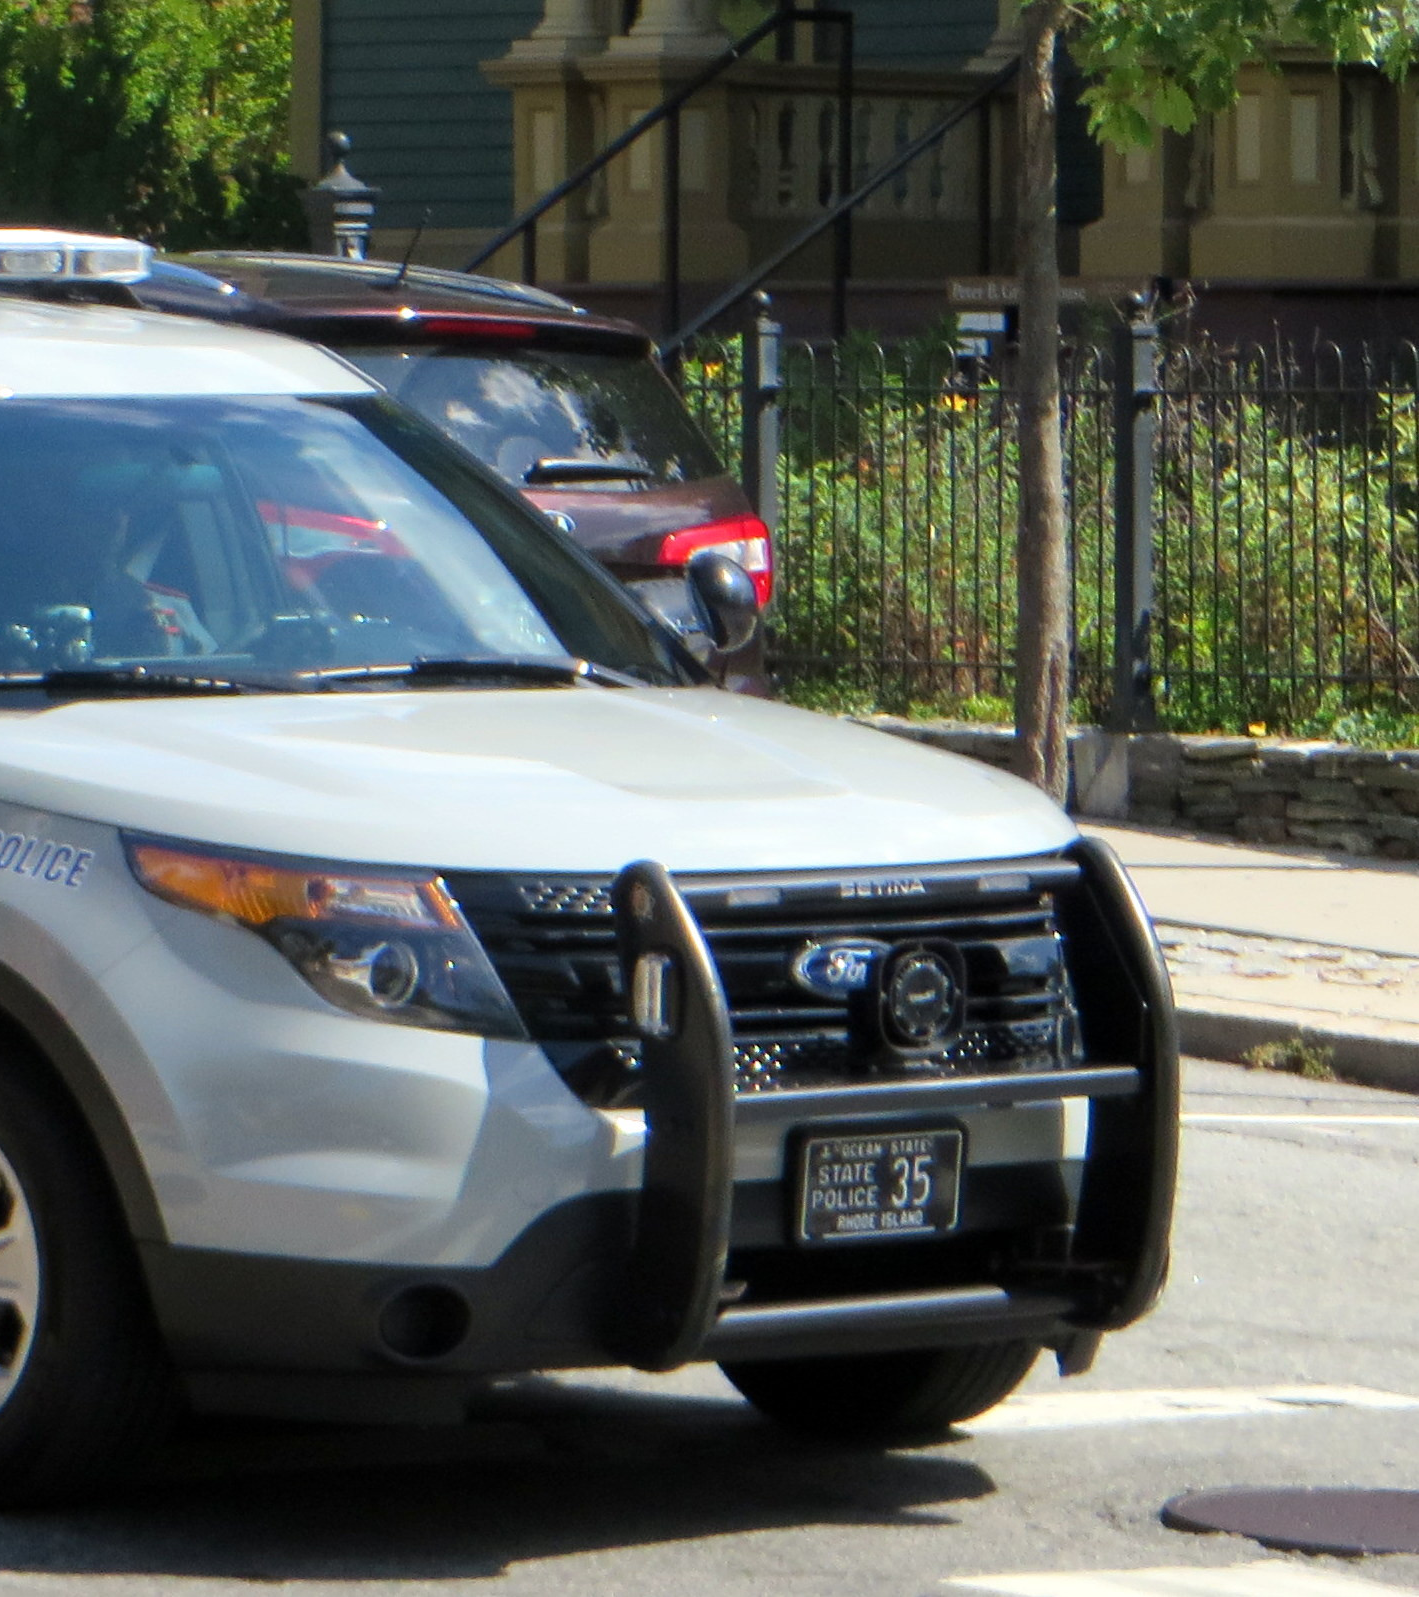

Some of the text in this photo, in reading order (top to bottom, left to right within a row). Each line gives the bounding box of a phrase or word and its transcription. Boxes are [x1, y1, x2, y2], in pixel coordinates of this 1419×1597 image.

[818, 1162, 876, 1185] STATE
[890, 1155, 932, 1208] 35
[811, 1185, 879, 1209] POLICE
[836, 1209, 924, 1230] RHODE ISLAND
